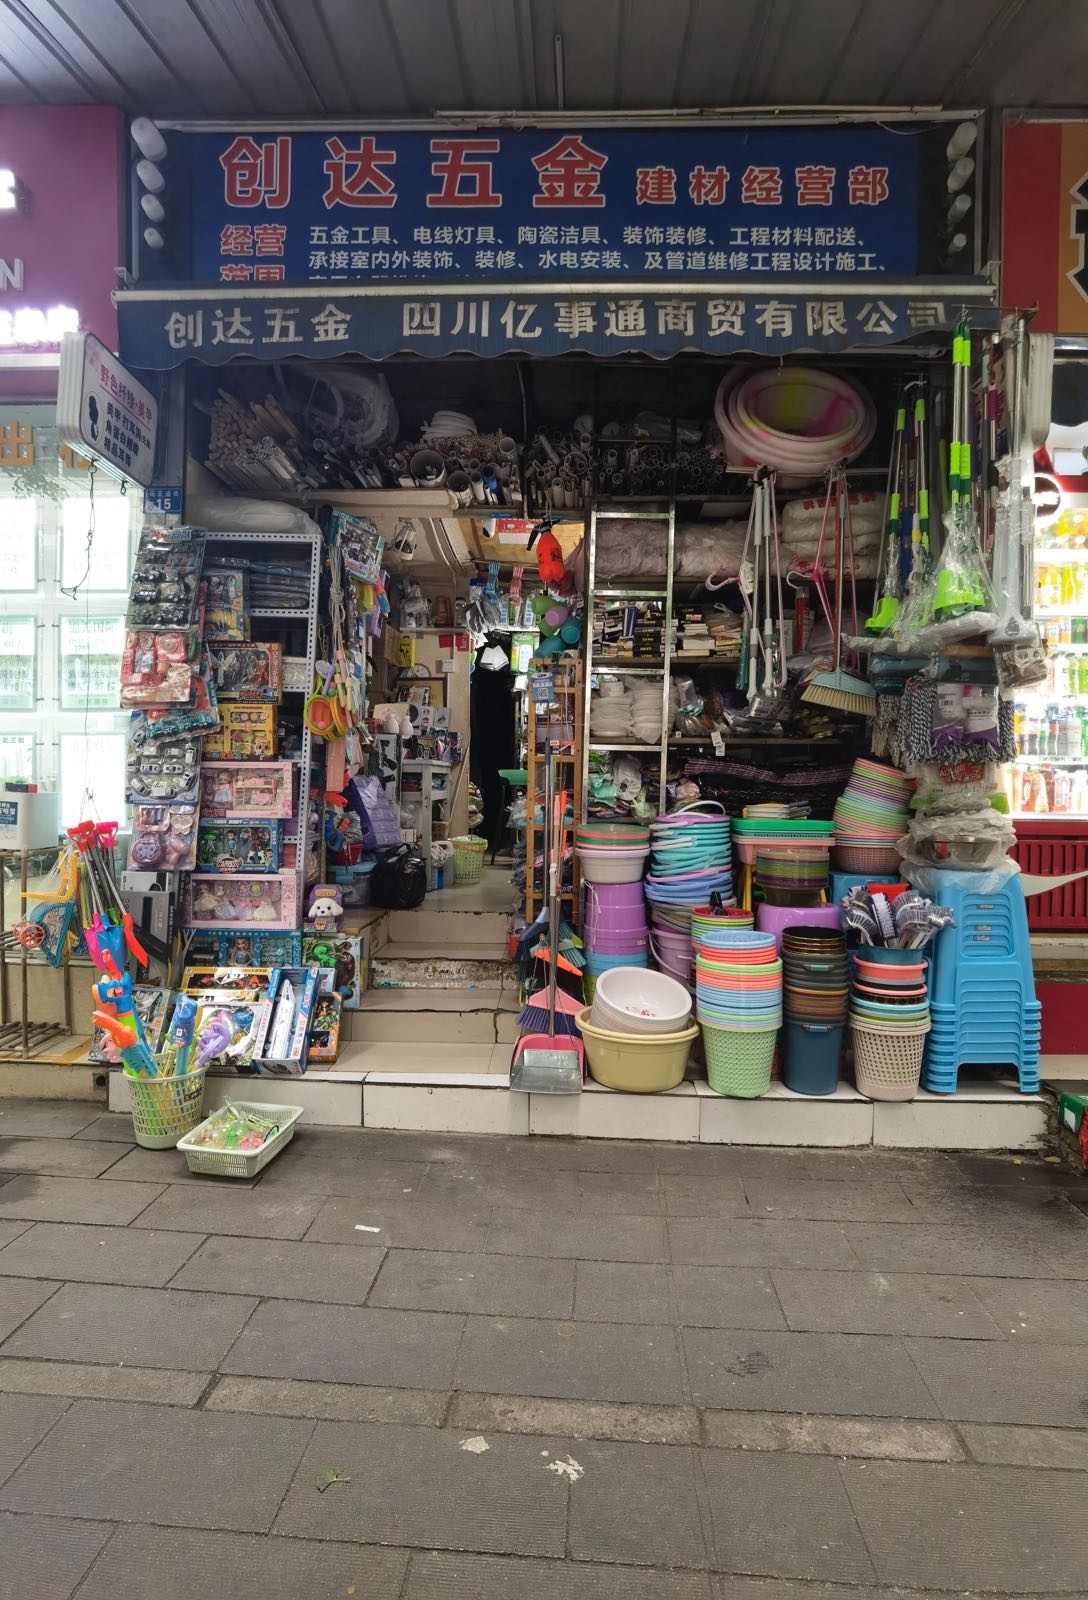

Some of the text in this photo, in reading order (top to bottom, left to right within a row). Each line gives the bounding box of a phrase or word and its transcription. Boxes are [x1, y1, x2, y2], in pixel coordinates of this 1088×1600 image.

[218, 136, 889, 208] 创达五金 建材经营部
[220, 224, 287, 256] 经营
[164, 299, 948, 348] 创达五金 四川亿事通商贸有限公司
[156, 498, 171, 510] 15
